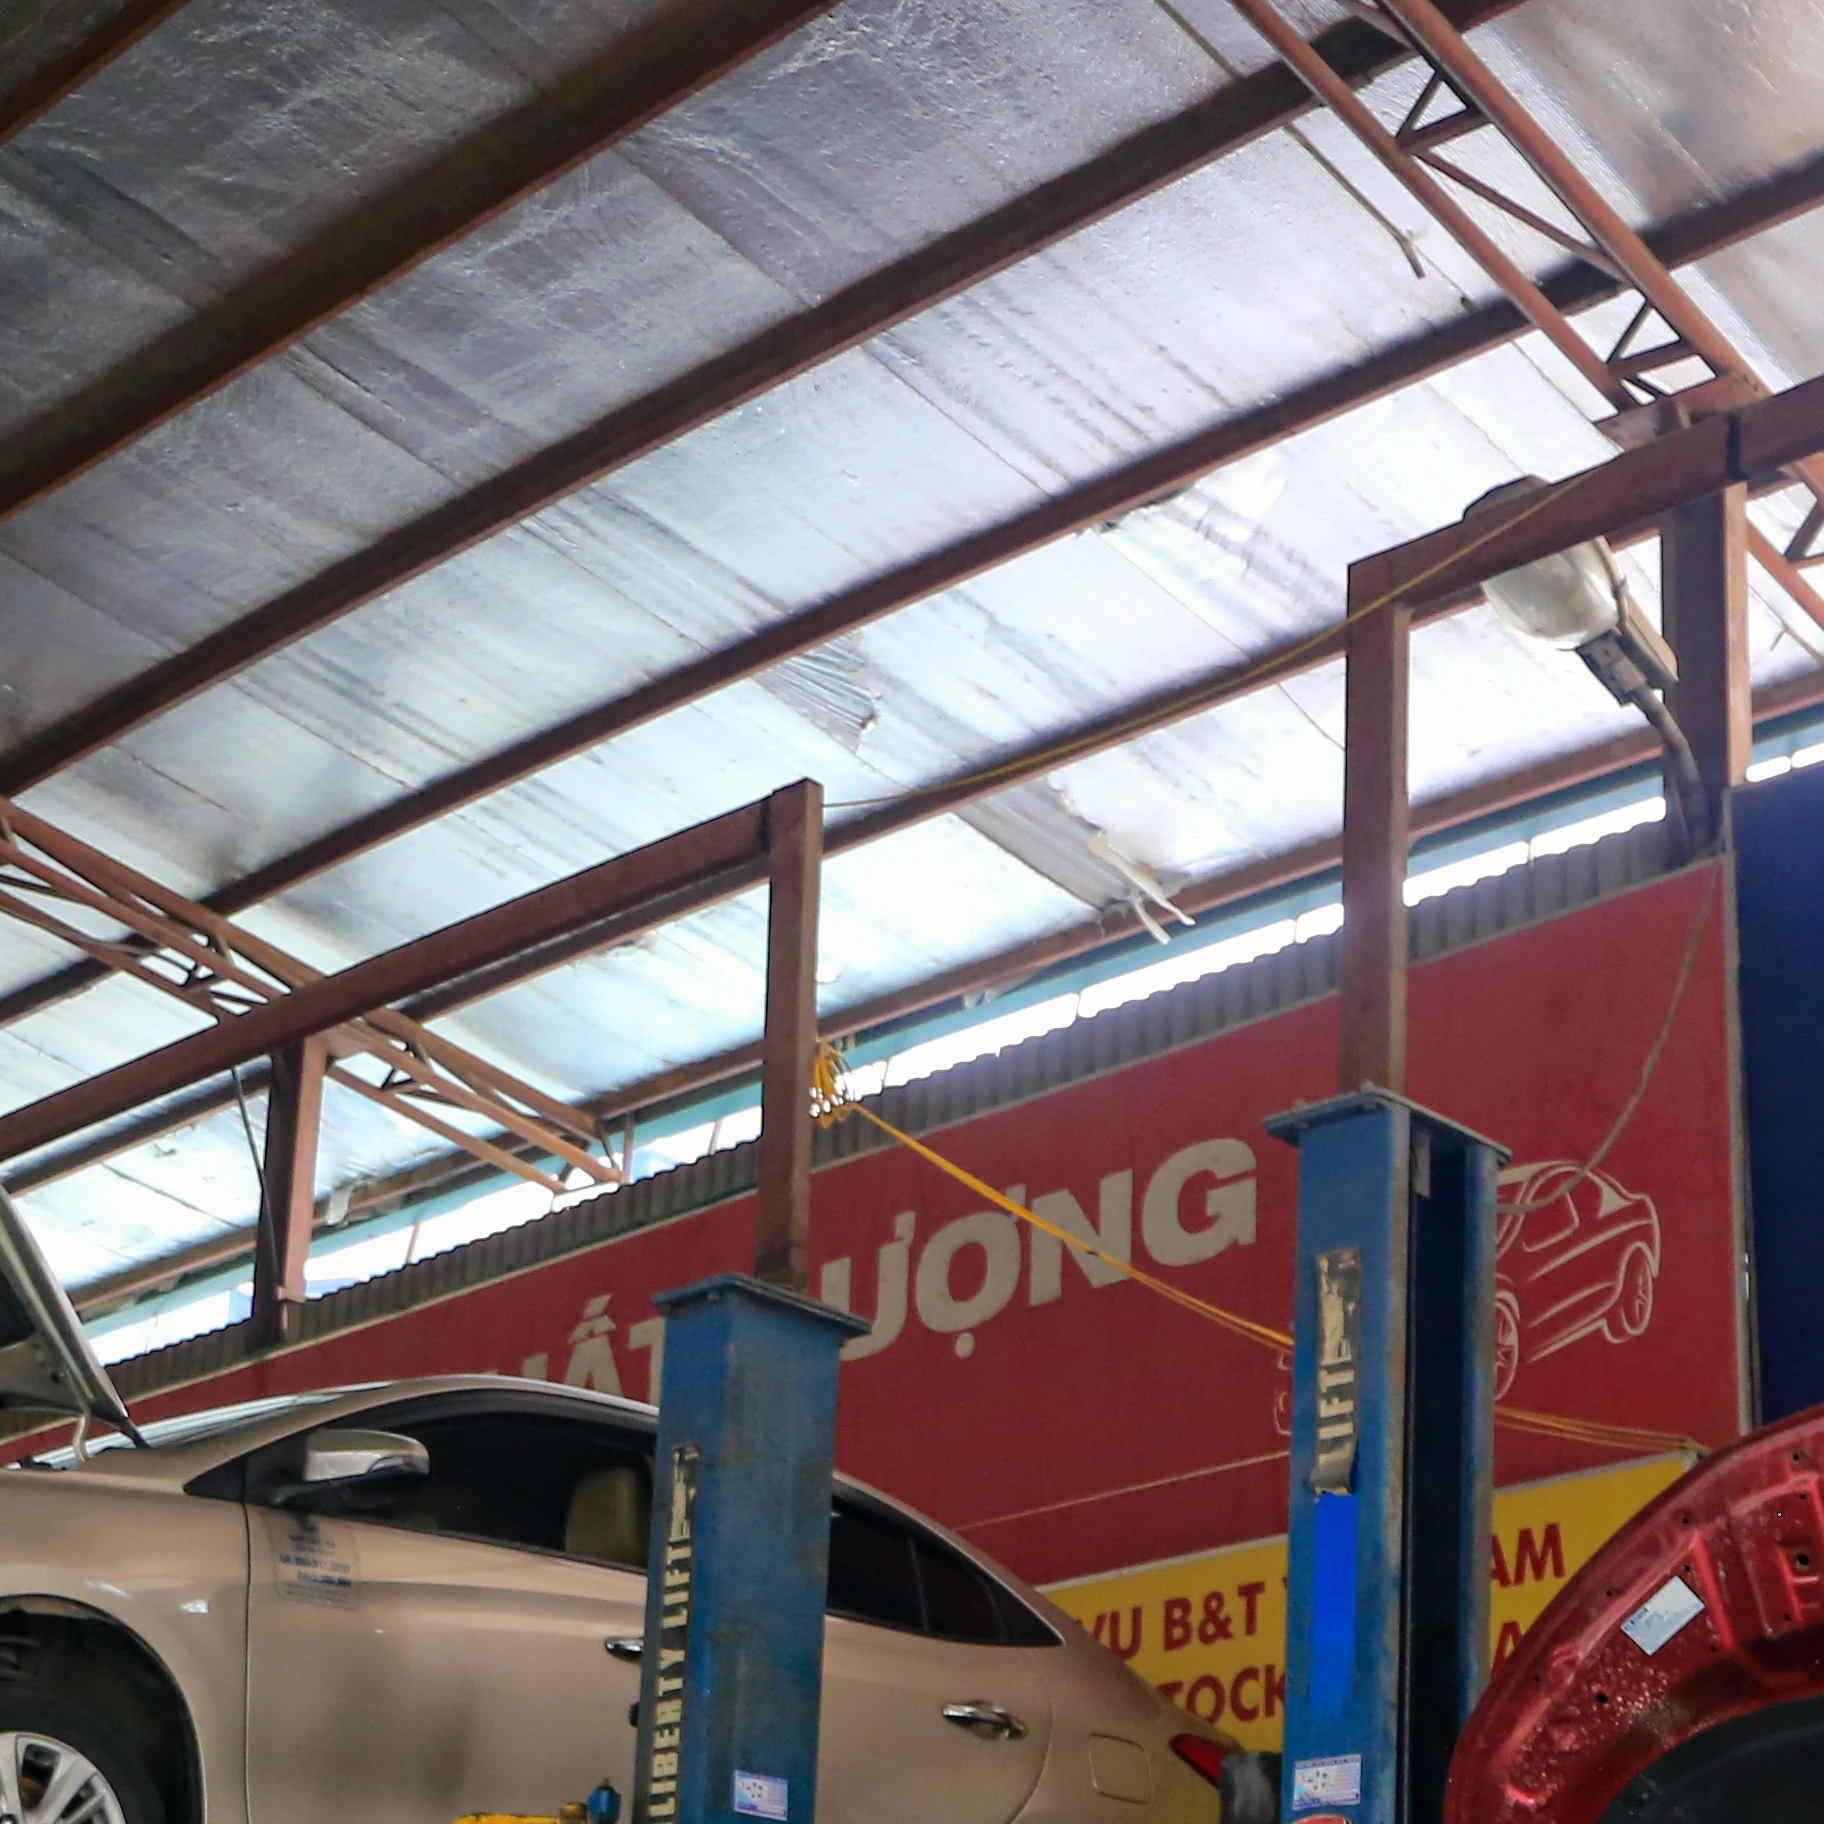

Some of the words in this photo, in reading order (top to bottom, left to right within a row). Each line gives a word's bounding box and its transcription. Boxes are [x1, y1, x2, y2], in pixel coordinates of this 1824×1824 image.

[661, 1545, 693, 1629] LIFT
[1162, 1581, 1267, 1652] B&T
[649, 1648, 686, 1816] LIBERTY
